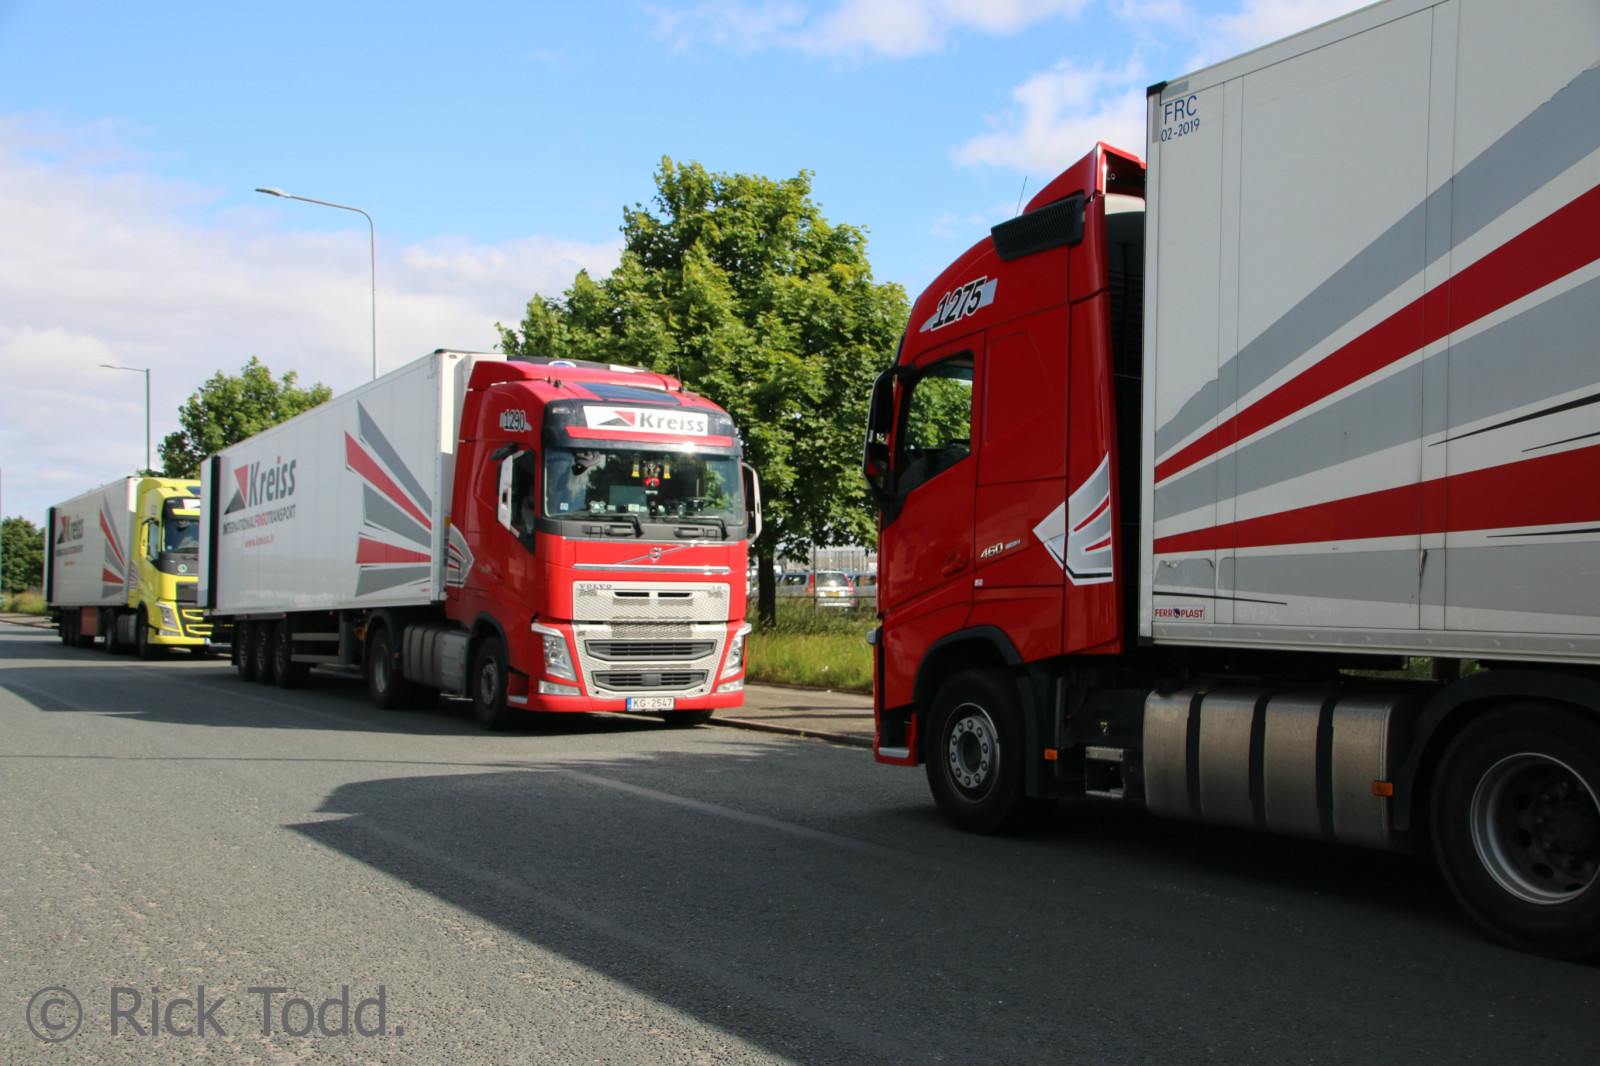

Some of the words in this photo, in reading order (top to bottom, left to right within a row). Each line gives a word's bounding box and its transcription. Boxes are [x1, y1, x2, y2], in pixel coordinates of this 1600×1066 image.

[1164, 95, 1197, 125] FRC
[1161, 118, 1200, 142] 02-2019
[931, 275, 988, 331] 1275
[504, 409, 526, 432] 1290
[640, 412, 704, 433] Kreiss
[248, 455, 297, 508] Kreiss
[980, 541, 1004, 558] 460
[633, 698, 673, 708] KG-2547
